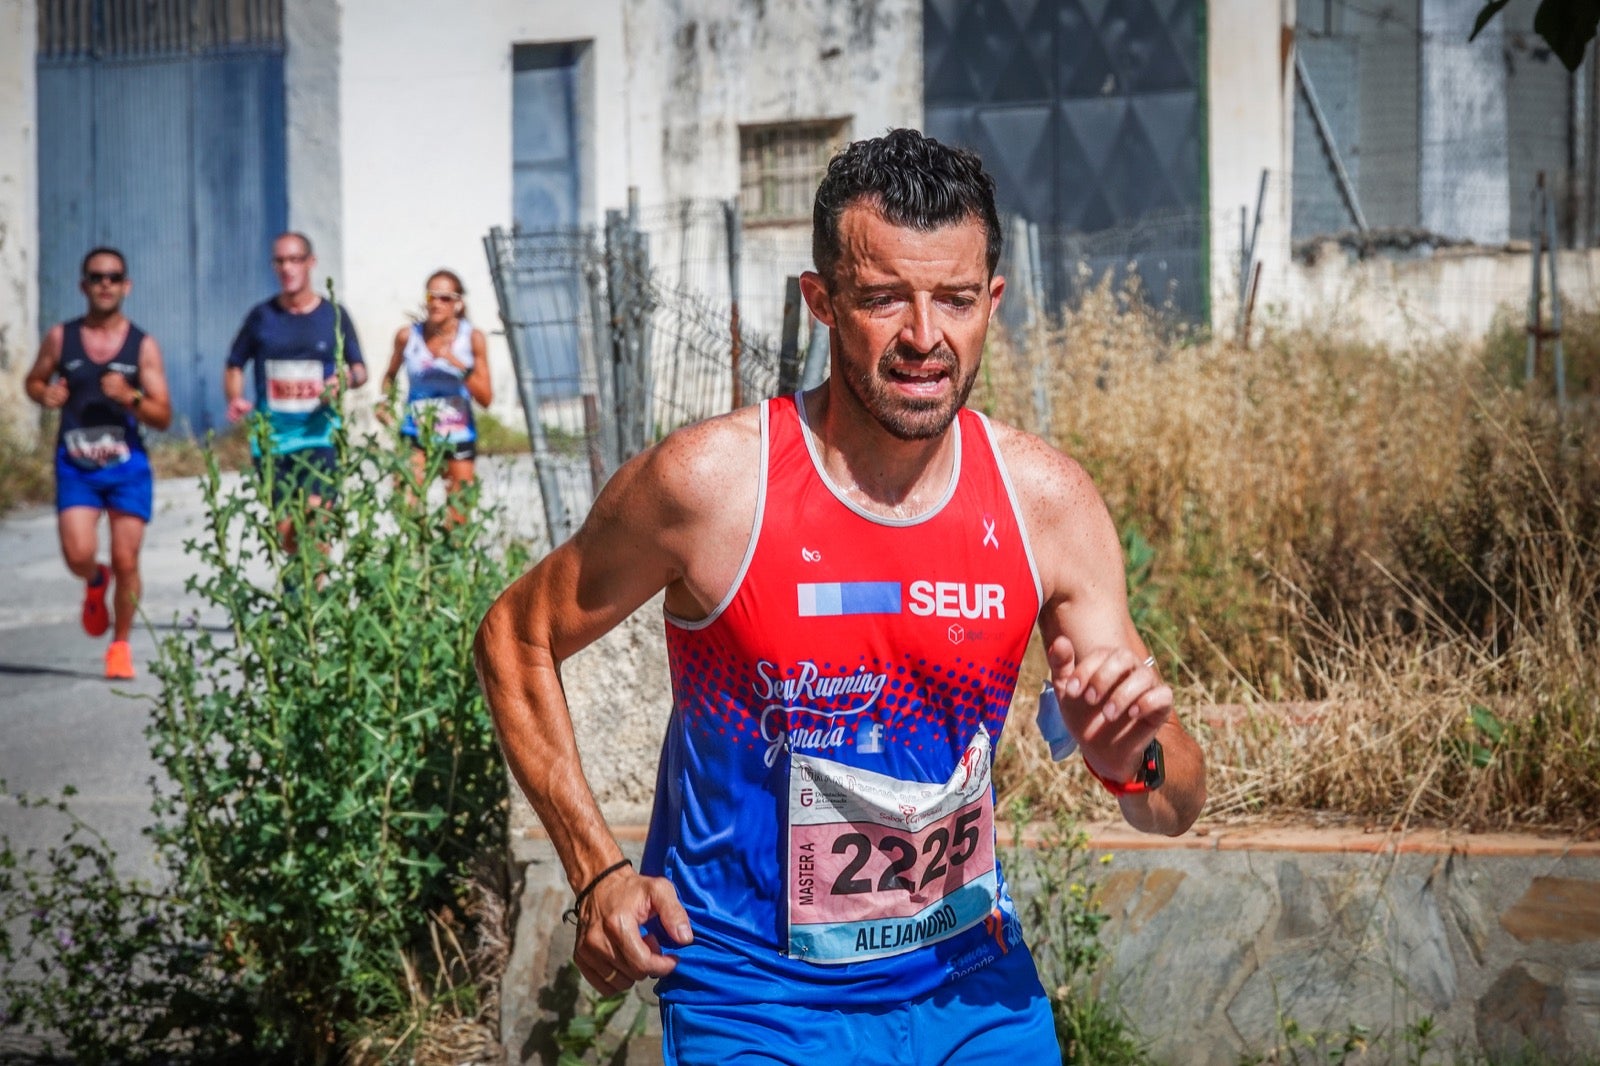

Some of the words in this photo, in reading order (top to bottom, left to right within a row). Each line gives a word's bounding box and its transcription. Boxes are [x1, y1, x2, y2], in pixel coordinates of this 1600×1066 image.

[908, 580, 1006, 619] SEUR
[800, 843, 815, 853] A
[830, 806, 982, 895] 2225
[799, 854, 815, 906] MASTER
[855, 904, 957, 951] ALEJANDRO
